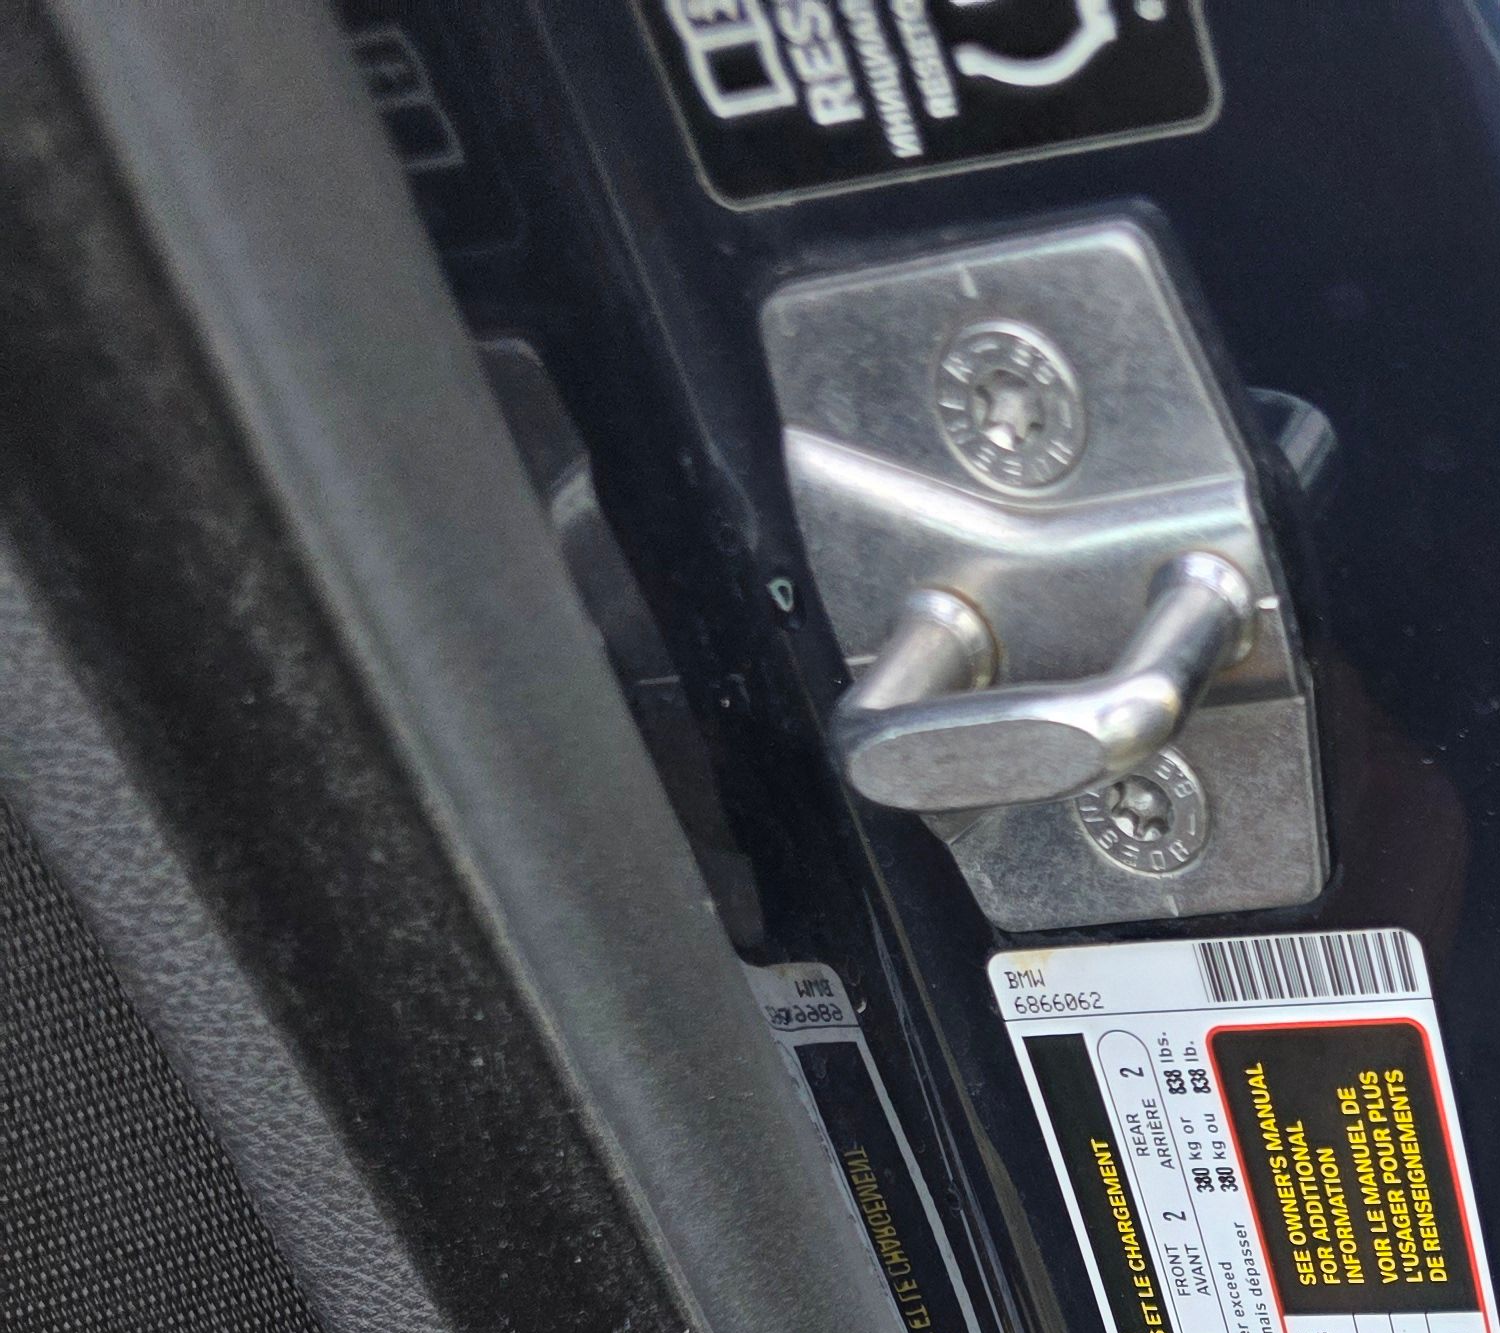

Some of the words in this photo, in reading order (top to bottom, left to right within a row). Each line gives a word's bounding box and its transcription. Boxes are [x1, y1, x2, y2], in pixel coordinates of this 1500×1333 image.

[1002, 968, 1047, 991] BMW
[1118, 1065, 1146, 1079] 2
[1182, 1040, 1200, 1063] lb.
[1244, 1061, 1285, 1152] MANUAL
[1335, 1086, 1362, 1116] DE
[1357, 1070, 1389, 1124] PLUS
[1124, 1112, 1152, 1158] REAR
[1140, 1097, 1177, 1171] ARRIÈRE
[1179, 1116, 1196, 1136] or
[1203, 1112, 1220, 1135] ou
[1186, 1140, 1203, 1161] kg
[1210, 1139, 1228, 1161] kg
[1345, 1118, 1383, 1206] MANUEL
[1371, 1127, 1403, 1185] POUR
[1383, 1068, 1442, 1253] RENSEIGNEMENTS
[1268, 1154, 1308, 1246] OWNER'S
[1284, 1119, 1332, 1243] ADDITIONAL
[1089, 1137, 1147, 1273] CHARGEMENT
[1161, 1210, 1188, 1223] 2
[1314, 1147, 1366, 1285] INFORMATION
[1365, 1208, 1389, 1234] LE
[1232, 1221, 1264, 1298] dépasser
[1386, 1188, 1425, 1284] L'USAGER
[1162, 1242, 1192, 1297] FRONT
[1182, 1242, 1213, 1297] AVANT
[1292, 1249, 1318, 1286] SEE
[1315, 1245, 1342, 1285] FOR
[1372, 1237, 1400, 1285] VOIR
[1424, 1254, 1449, 1283] DE
[1132, 1274, 1155, 1299] LE
[1216, 1260, 1246, 1319] exceed
[1139, 1300, 1163, 1326] ET
